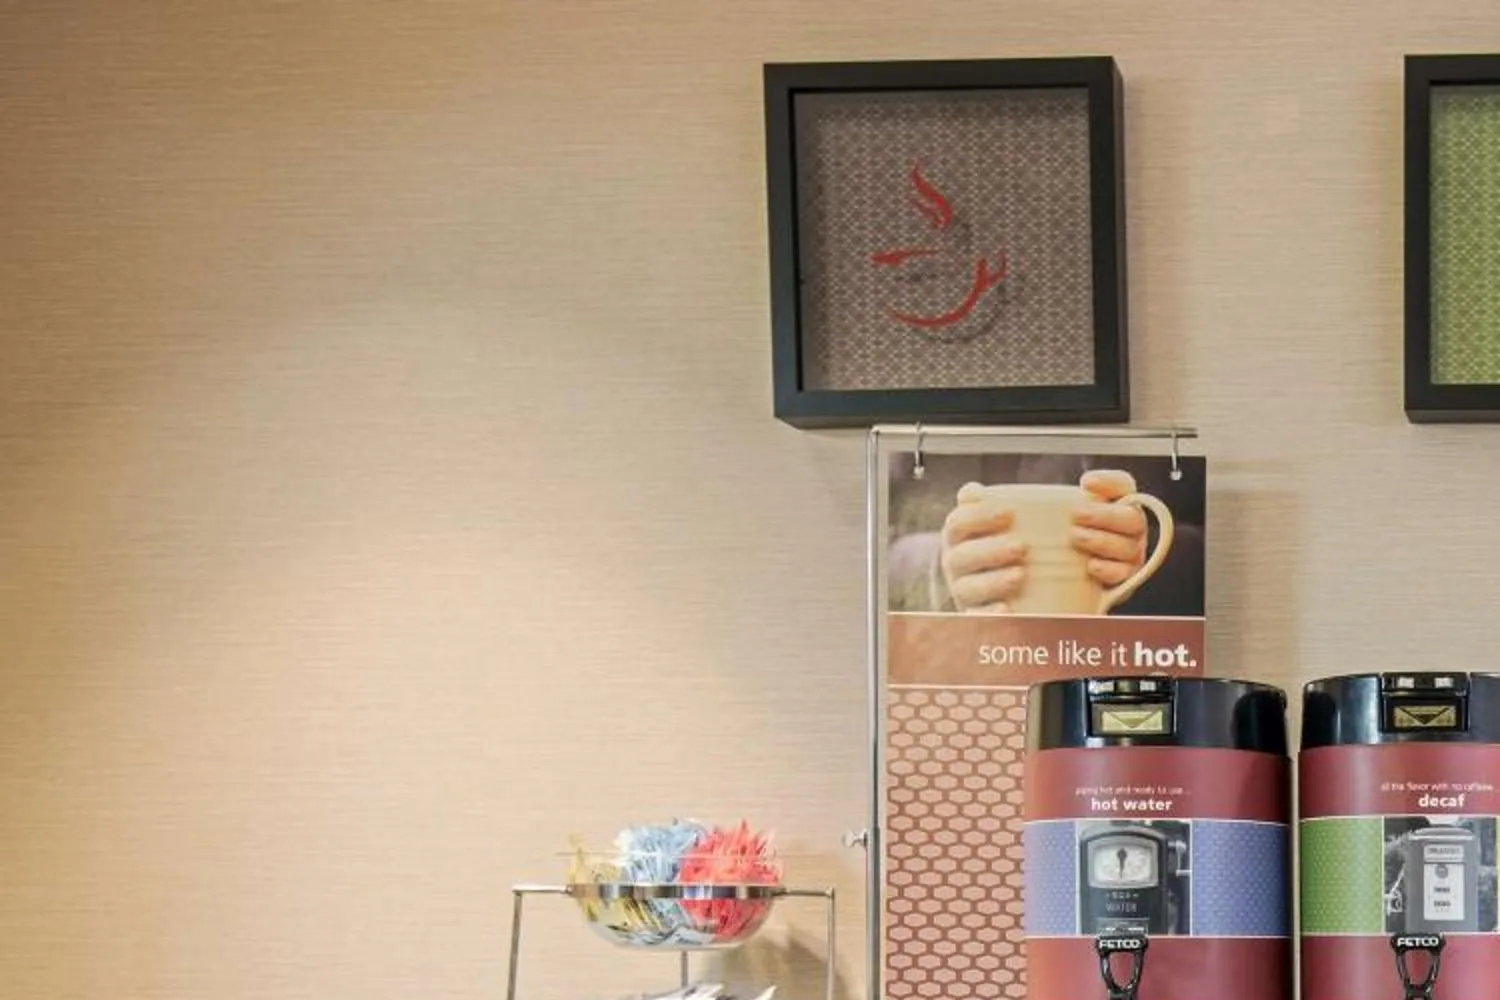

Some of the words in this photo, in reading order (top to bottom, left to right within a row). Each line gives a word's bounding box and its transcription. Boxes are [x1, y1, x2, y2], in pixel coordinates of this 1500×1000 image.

[978, 643, 1049, 667] some
[1057, 640, 1101, 668] like
[1111, 640, 1128, 668] it
[1132, 640, 1198, 668] hot.
[1090, 798, 1118, 811] hot
[1123, 798, 1173, 811] water
[1418, 793, 1466, 807] decaf
[1098, 939, 1141, 949] FETCO
[1396, 936, 1440, 947] FETCO
